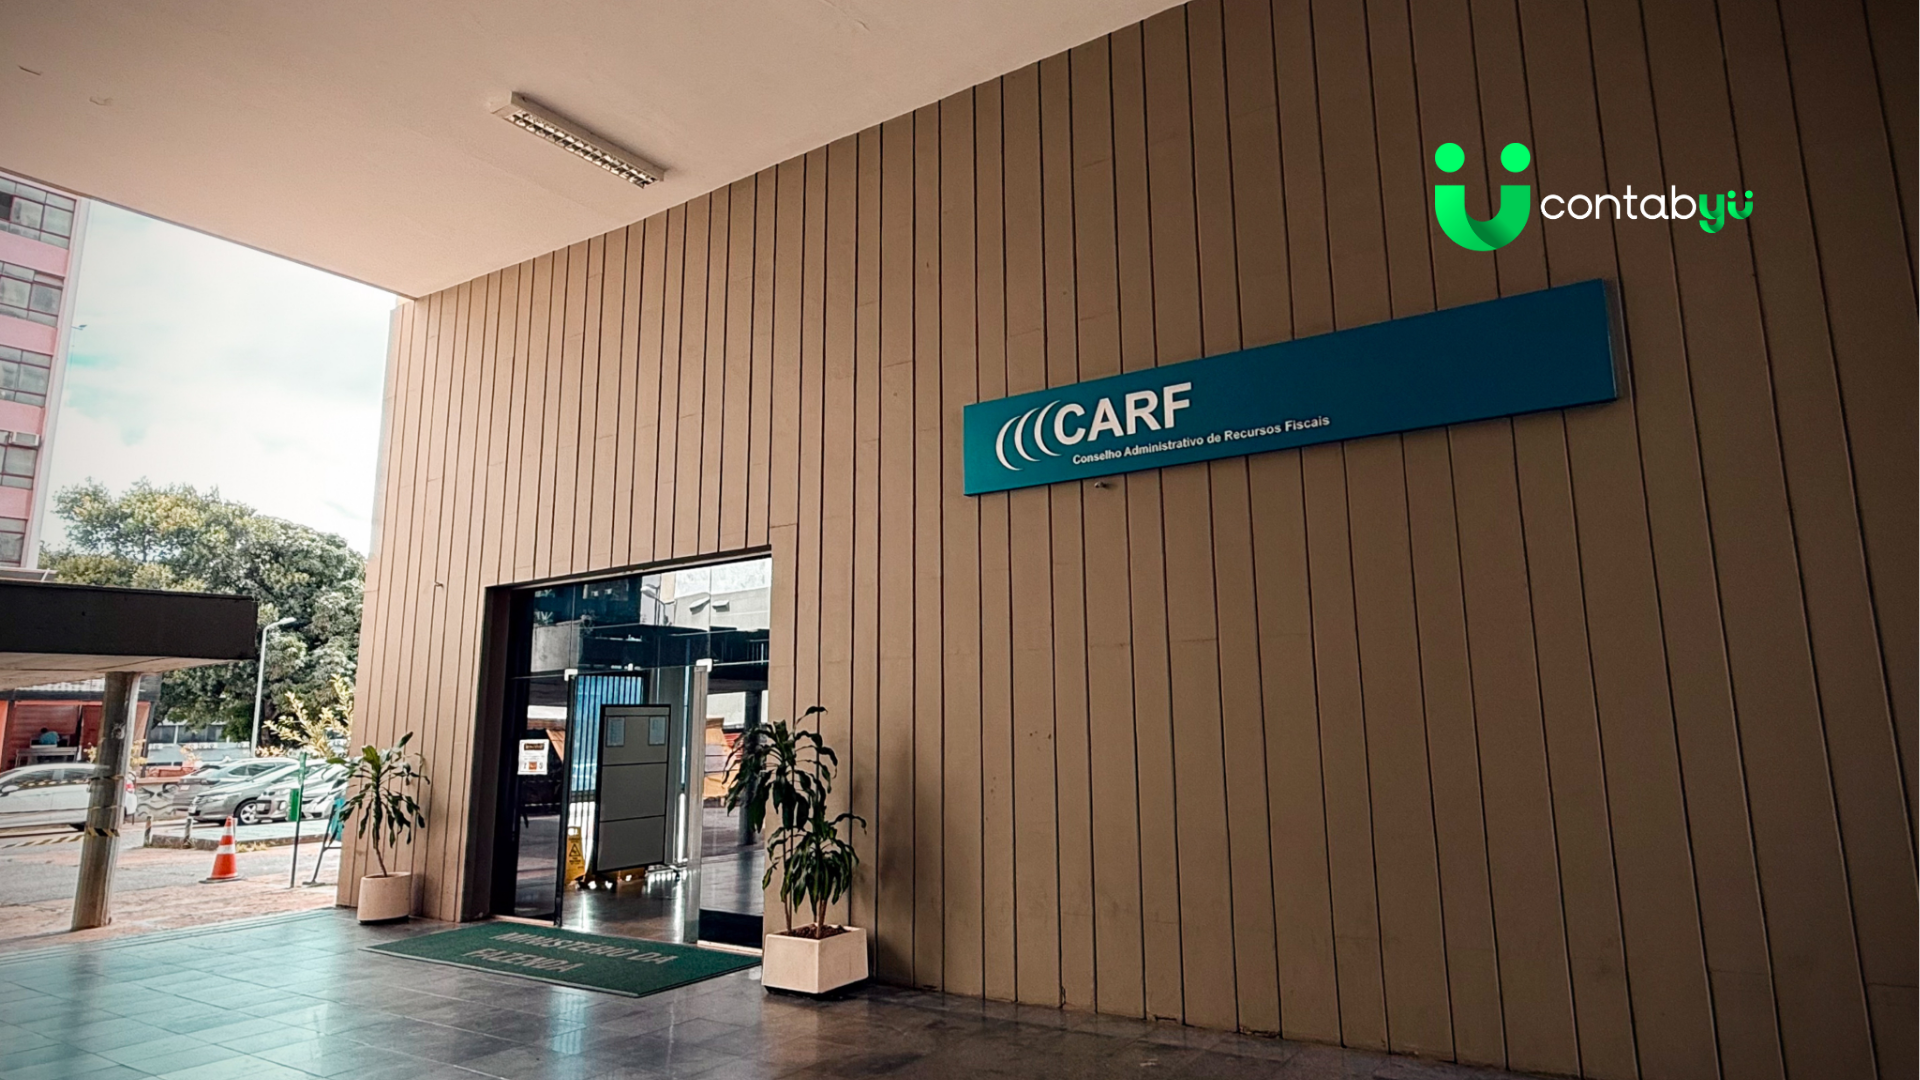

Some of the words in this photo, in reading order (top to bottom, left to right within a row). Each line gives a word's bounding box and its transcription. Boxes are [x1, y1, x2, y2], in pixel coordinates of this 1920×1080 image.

[1053, 382, 1192, 445] CARF
[1072, 449, 1122, 465] Conselho
[1124, 436, 1204, 457] Administrativo
[1206, 432, 1222, 444] de
[1224, 424, 1281, 441] Recursos
[1284, 415, 1330, 432] Fiscais
[461, 948, 584, 973] FAZENDA
[626, 951, 679, 964] DA
